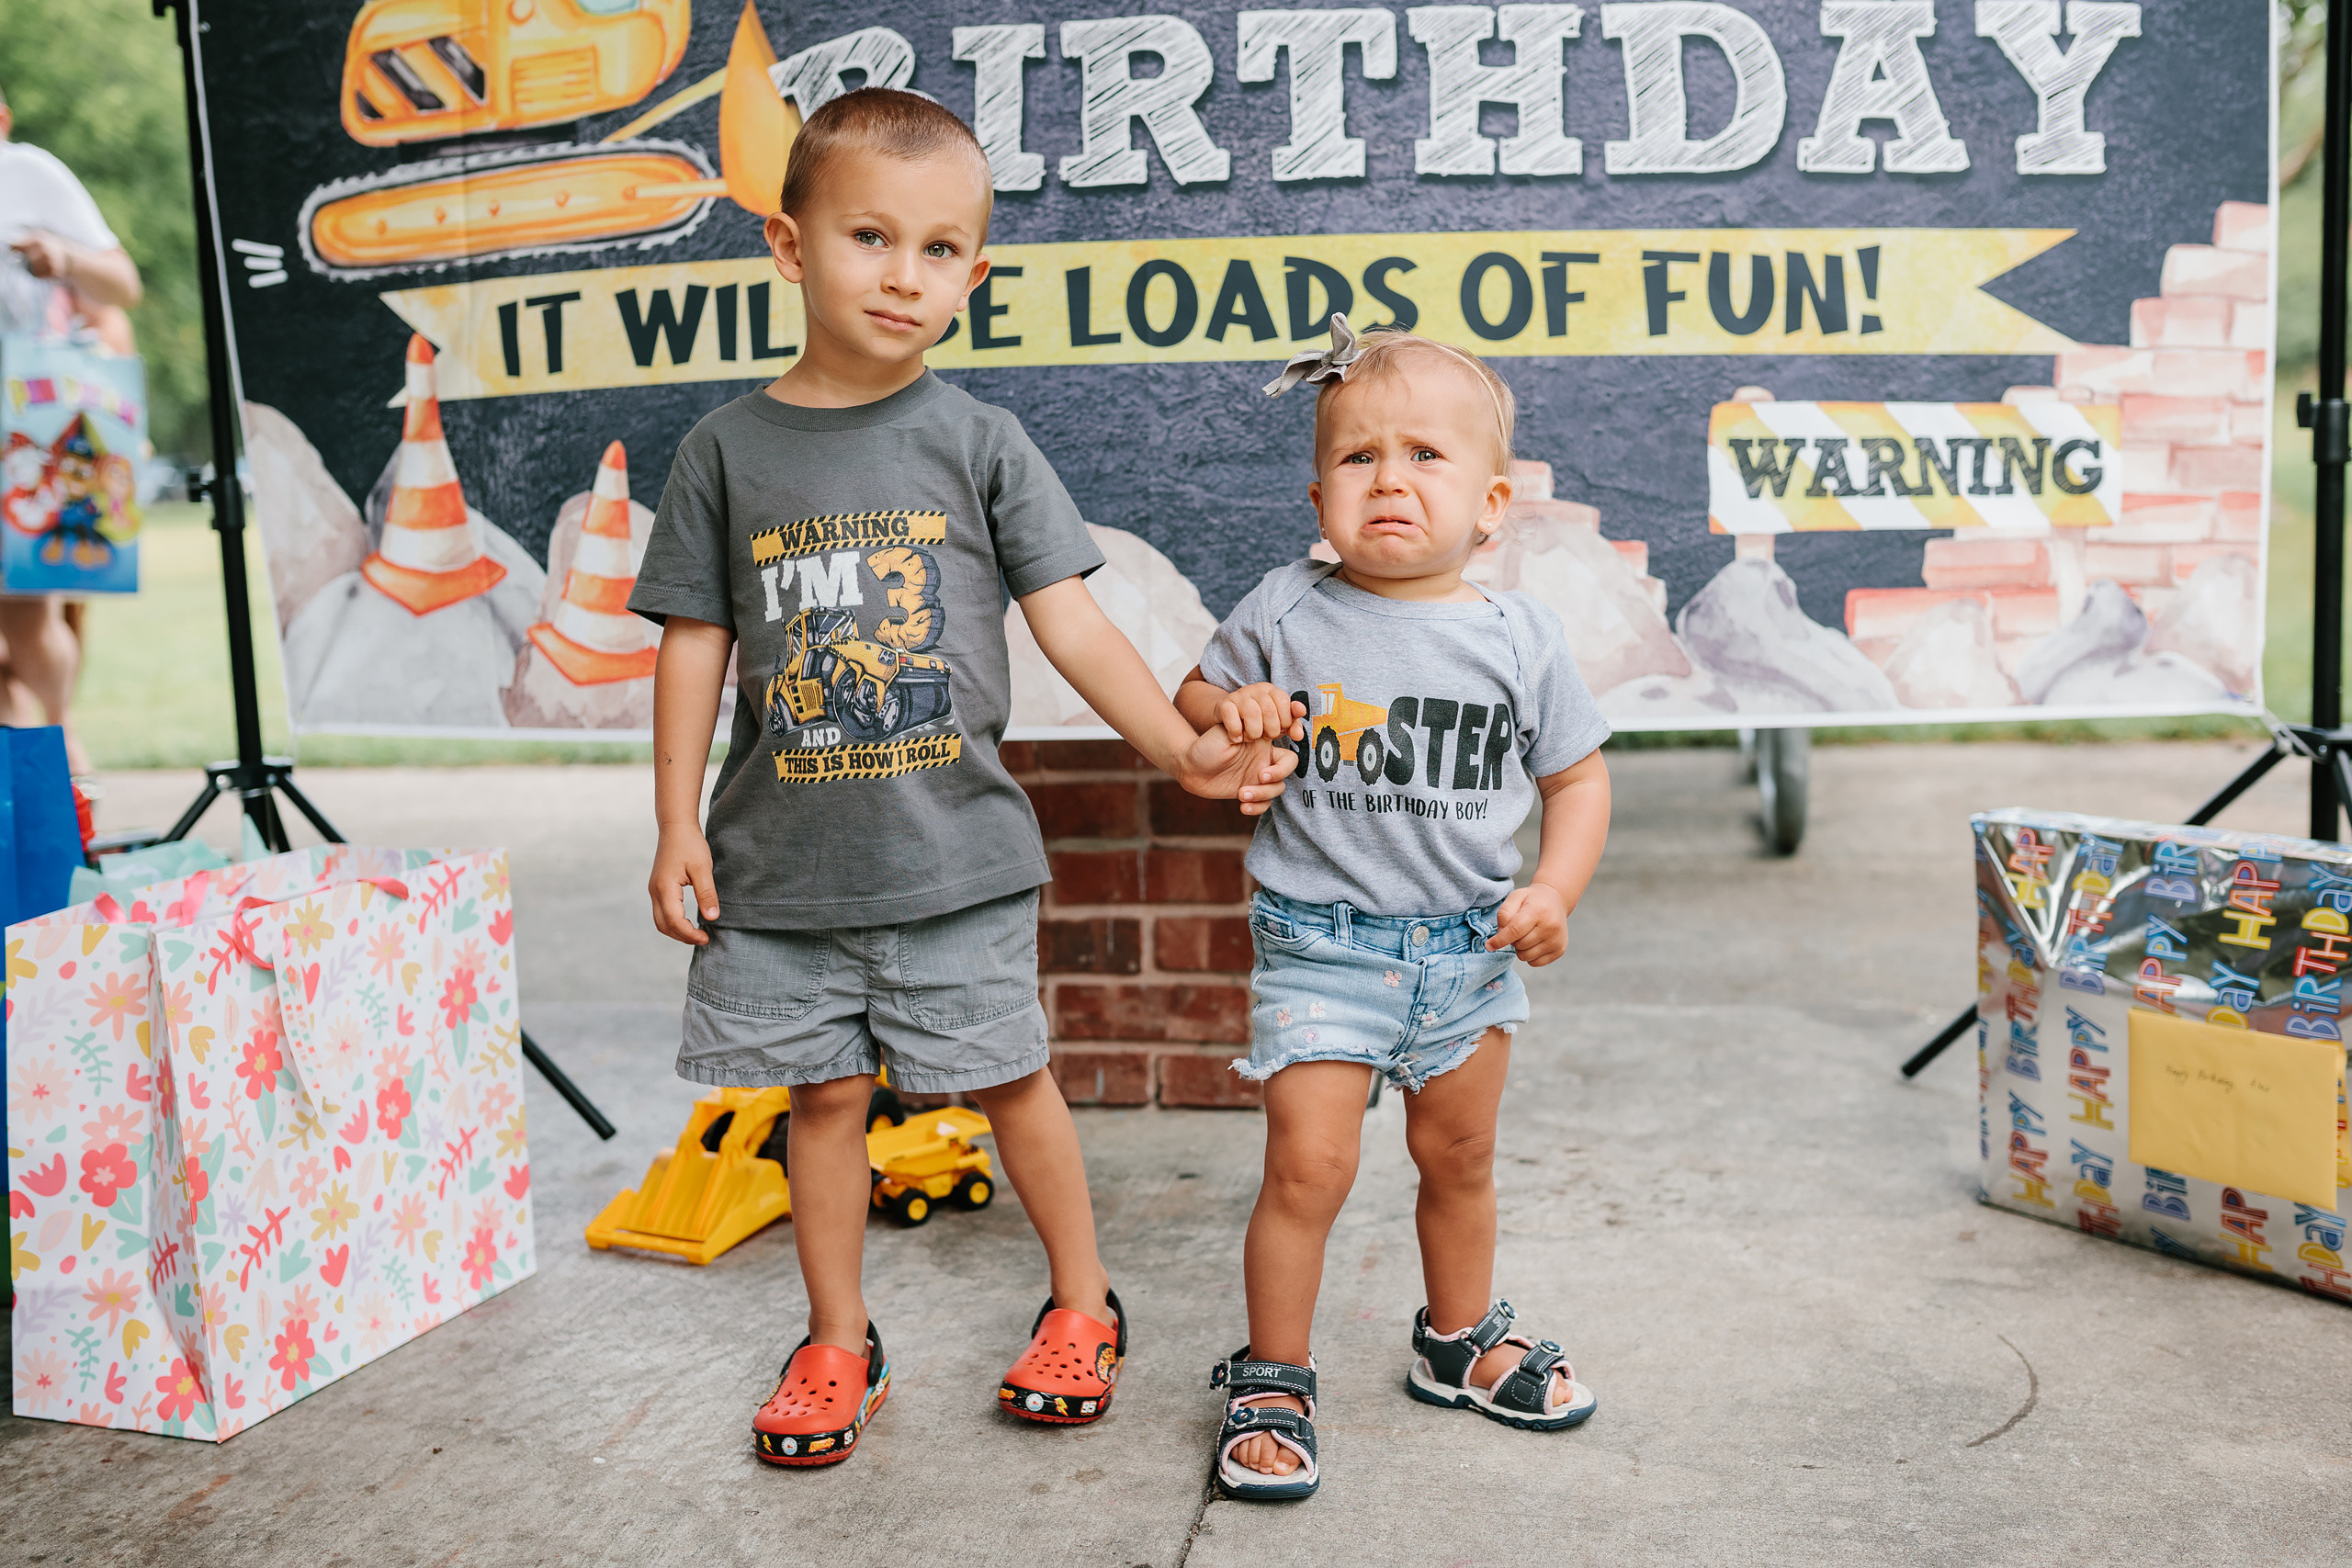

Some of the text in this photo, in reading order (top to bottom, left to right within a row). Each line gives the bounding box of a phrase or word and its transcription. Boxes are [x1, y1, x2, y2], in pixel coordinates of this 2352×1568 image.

[496, 244, 1885, 378] IT WIL E LOADS OF FUN!
[1728, 436, 2105, 499] WARNING
[779, 516, 910, 551] WARNING
[761, 546, 945, 653] I'M 3
[784, 742, 951, 774] THIS IS HOW I ROLL
[801, 727, 842, 748] AND
[1302, 789, 1488, 821] OF THE BIRTHDAY BOY!
[2003, 827, 2055, 910] HAP
[2133, 912, 2188, 1017] APPY
[2066, 1004, 2115, 1131] HAPPY
[2219, 1185, 2274, 1274] HAP
[1242, 1366, 1282, 1378] SPORT
[1080, 1401, 1098, 1416] 95
